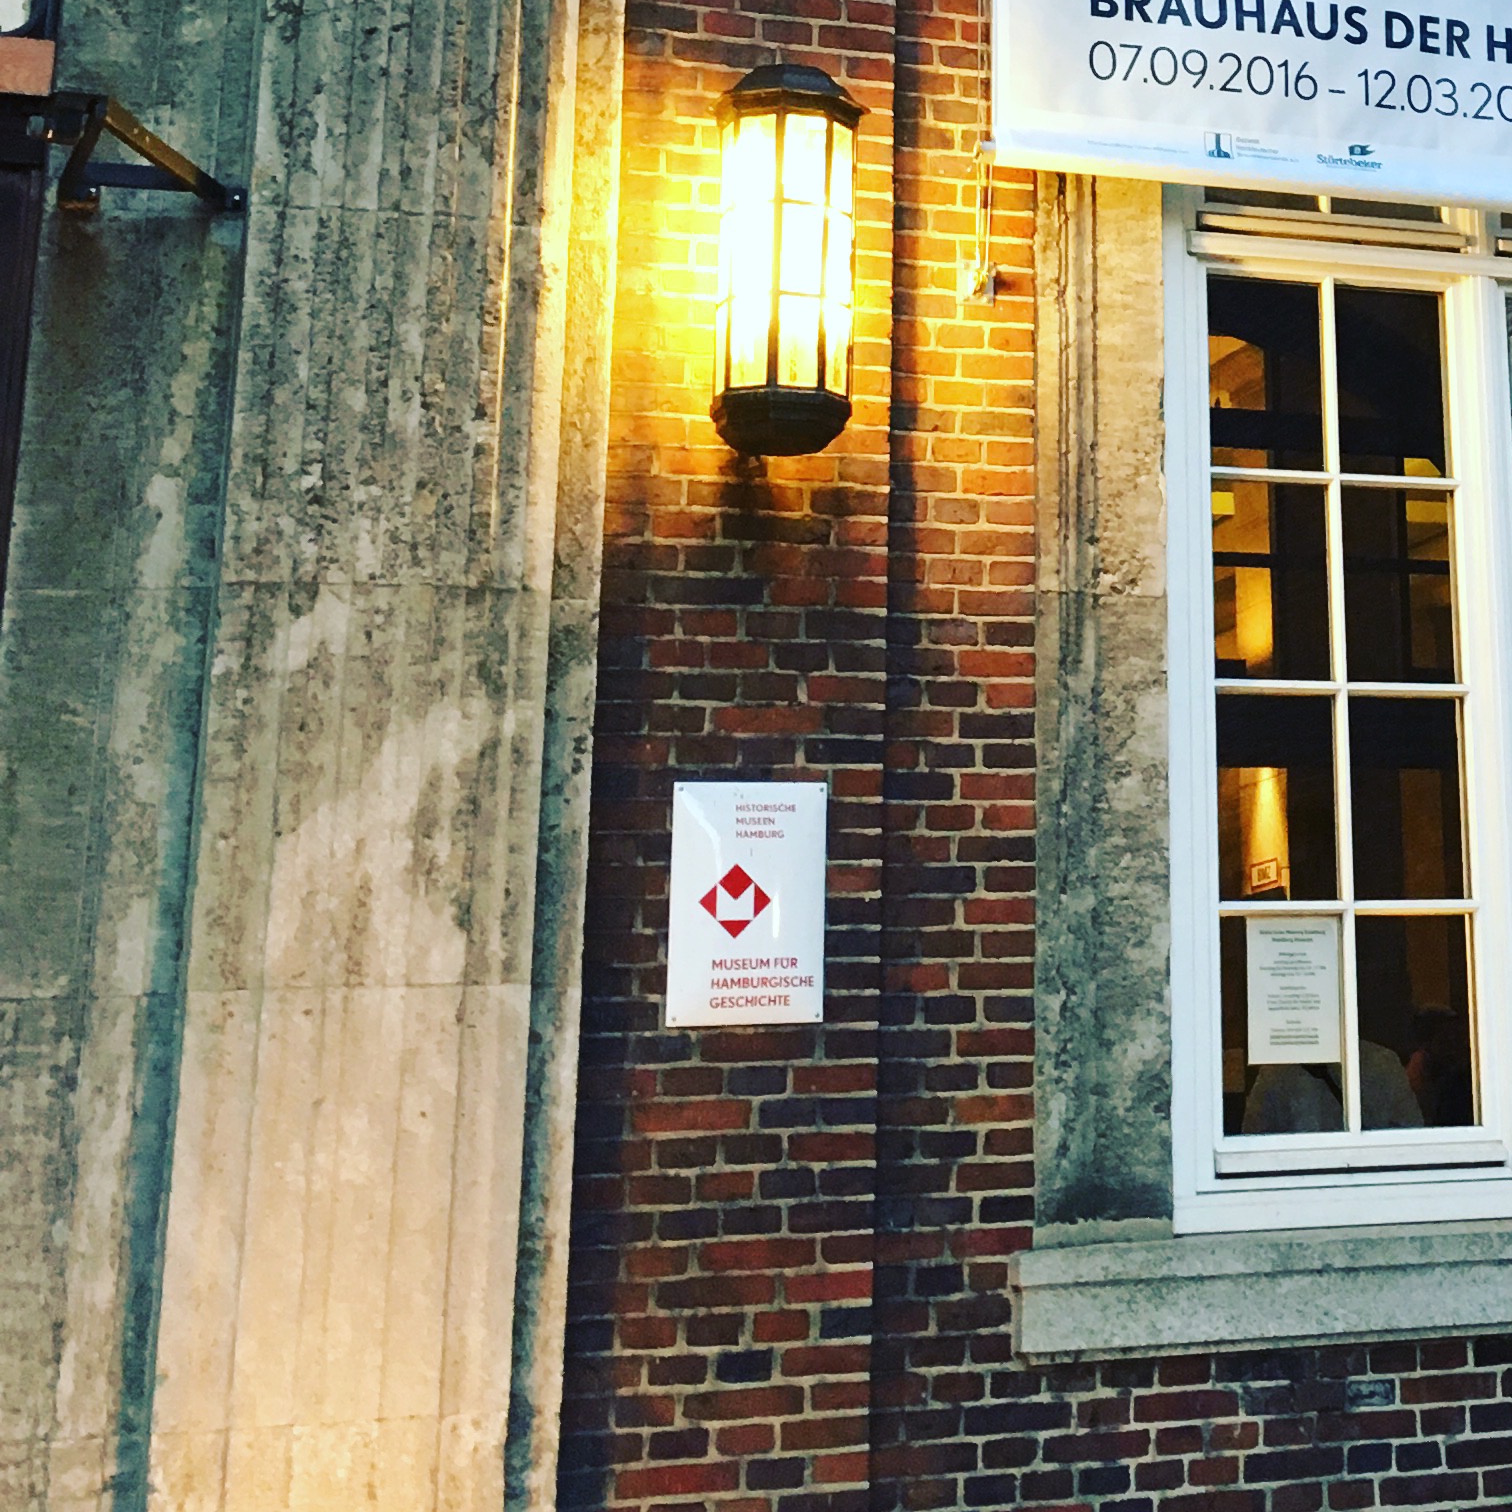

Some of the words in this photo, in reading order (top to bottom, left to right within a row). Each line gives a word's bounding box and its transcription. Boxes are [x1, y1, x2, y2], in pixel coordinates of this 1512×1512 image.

[1384, 10, 1471, 59] DER
[1088, 40, 1318, 101] 07.09.2016
[735, 803, 797, 813] HISTORISCHE
[735, 817, 776, 826] MUSEEN
[735, 830, 785, 839] HAMBURG
[711, 958, 771, 971] MUSEUM
[773, 957, 799, 970] FÜR
[710, 975, 815, 990] HAMBURGISCHE
[709, 994, 791, 1010] GESCHICHTE
